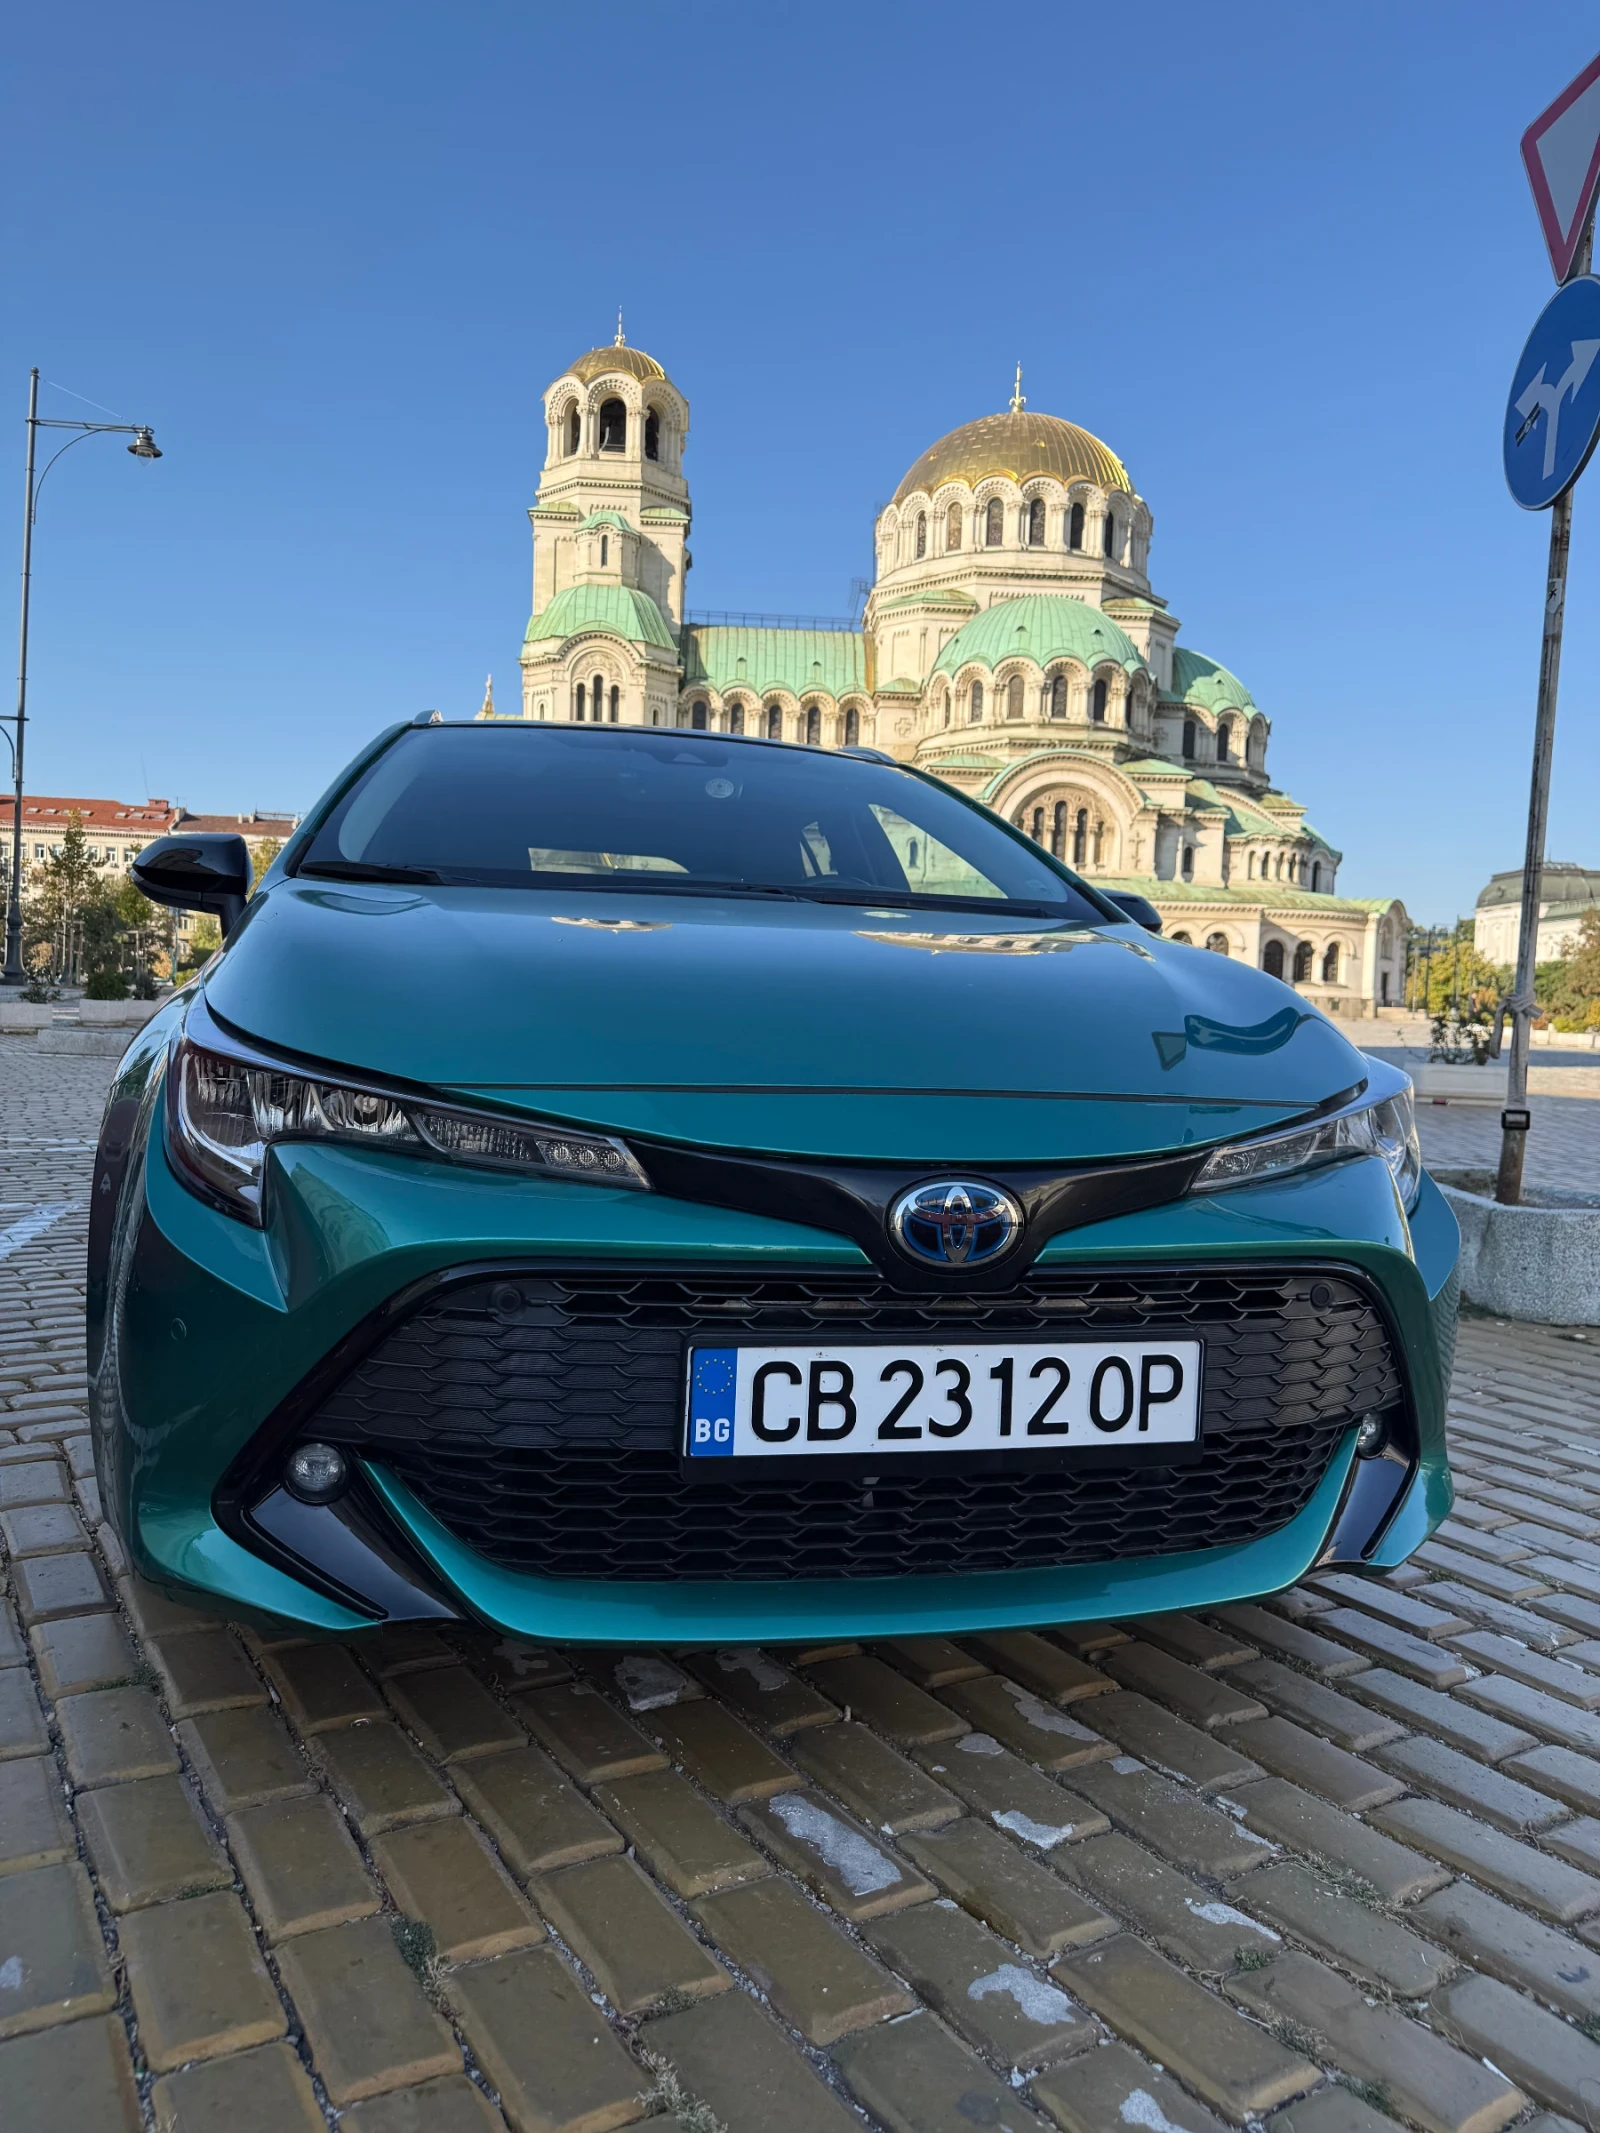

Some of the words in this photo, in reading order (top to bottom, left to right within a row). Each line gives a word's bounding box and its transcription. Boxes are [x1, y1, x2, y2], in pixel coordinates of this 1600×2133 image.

[751, 1360, 857, 1442] CB
[877, 1356, 1071, 1440] 2312
[695, 1418, 730, 1443] BG
